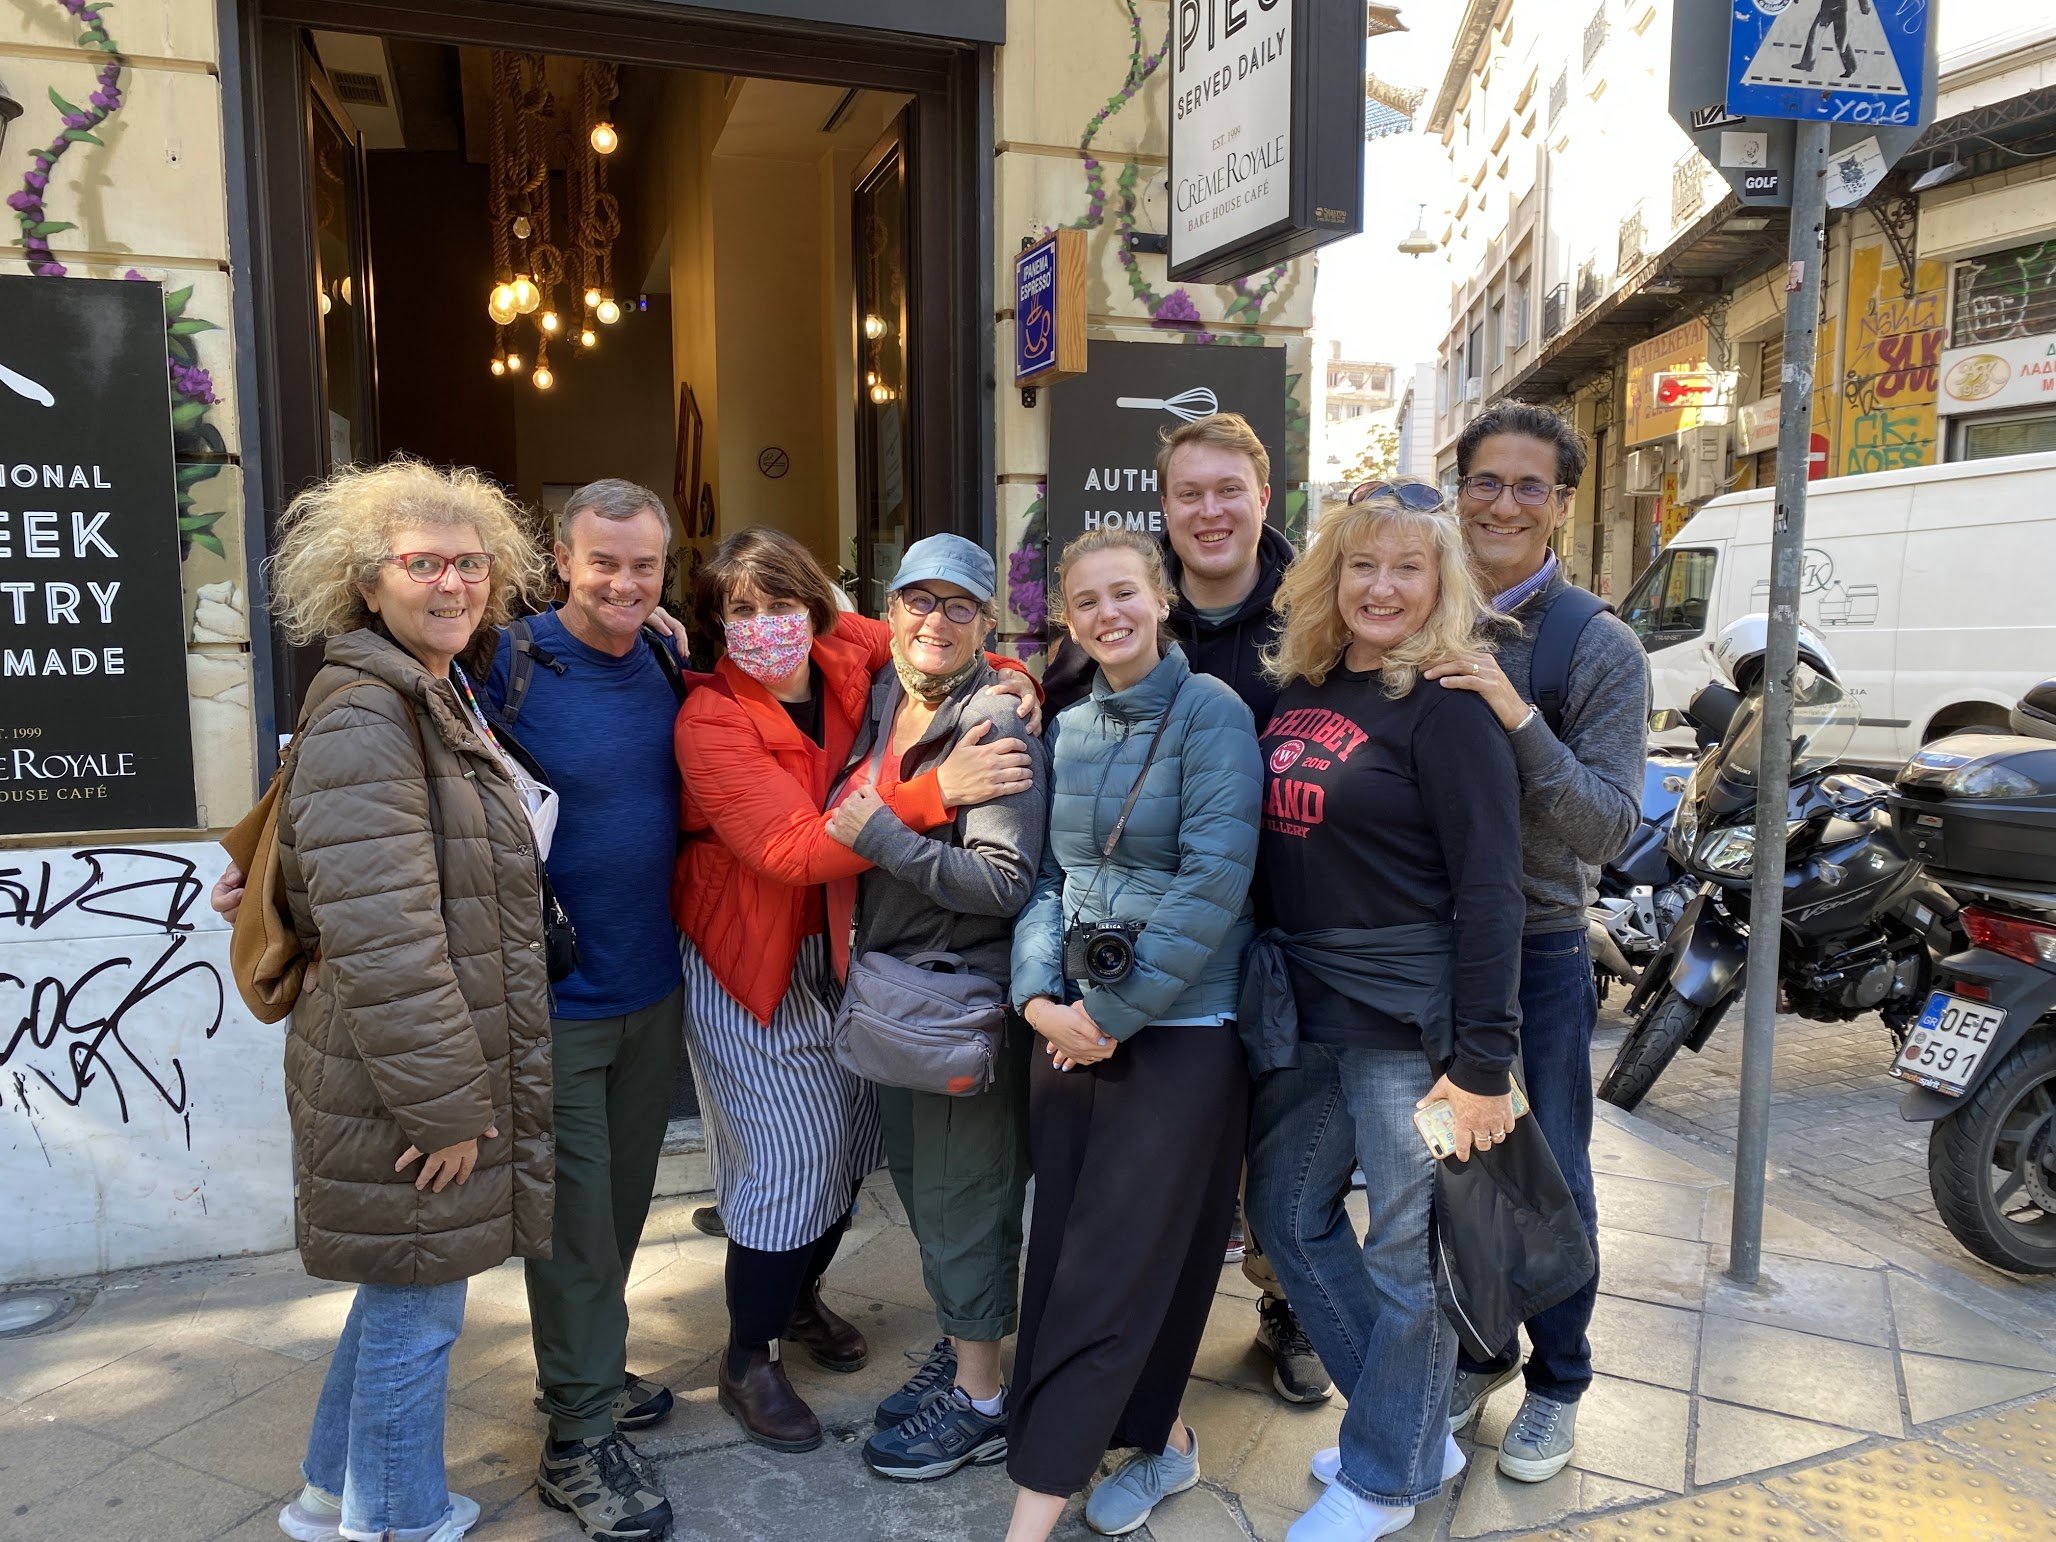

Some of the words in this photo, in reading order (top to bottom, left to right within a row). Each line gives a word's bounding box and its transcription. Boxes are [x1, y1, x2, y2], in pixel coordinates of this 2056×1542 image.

[1180, 0, 1279, 73] PIE
[1177, 65, 1232, 120] SERVED
[1238, 28, 1286, 81] DAILY
[1227, 125, 1241, 147] 1999
[1745, 177, 1778, 189] GOLF
[1188, 211, 1210, 232] BAKE
[1212, 195, 1242, 219] HOUSE
[1244, 179, 1270, 204] CAFÉ
[1023, 255, 1049, 282] IPANEMA
[1020, 272, 1051, 302] ESPRESSO
[1084, 468, 1158, 492] AUTH
[1084, 510, 1162, 533] HOME
[0, 582, 121, 625] TRY
[3, 648, 125, 677] MADE
[13, 727, 42, 739] 1999
[1278, 749, 1293, 763] W
[1301, 756, 1332, 771] 2010
[56, 784, 108, 800] CAFÉ
[1263, 777, 1326, 825] AND
[1922, 1015, 1939, 1027] GR
[1939, 1007, 1998, 1044] OEE
[1920, 1041, 1978, 1079] 591
